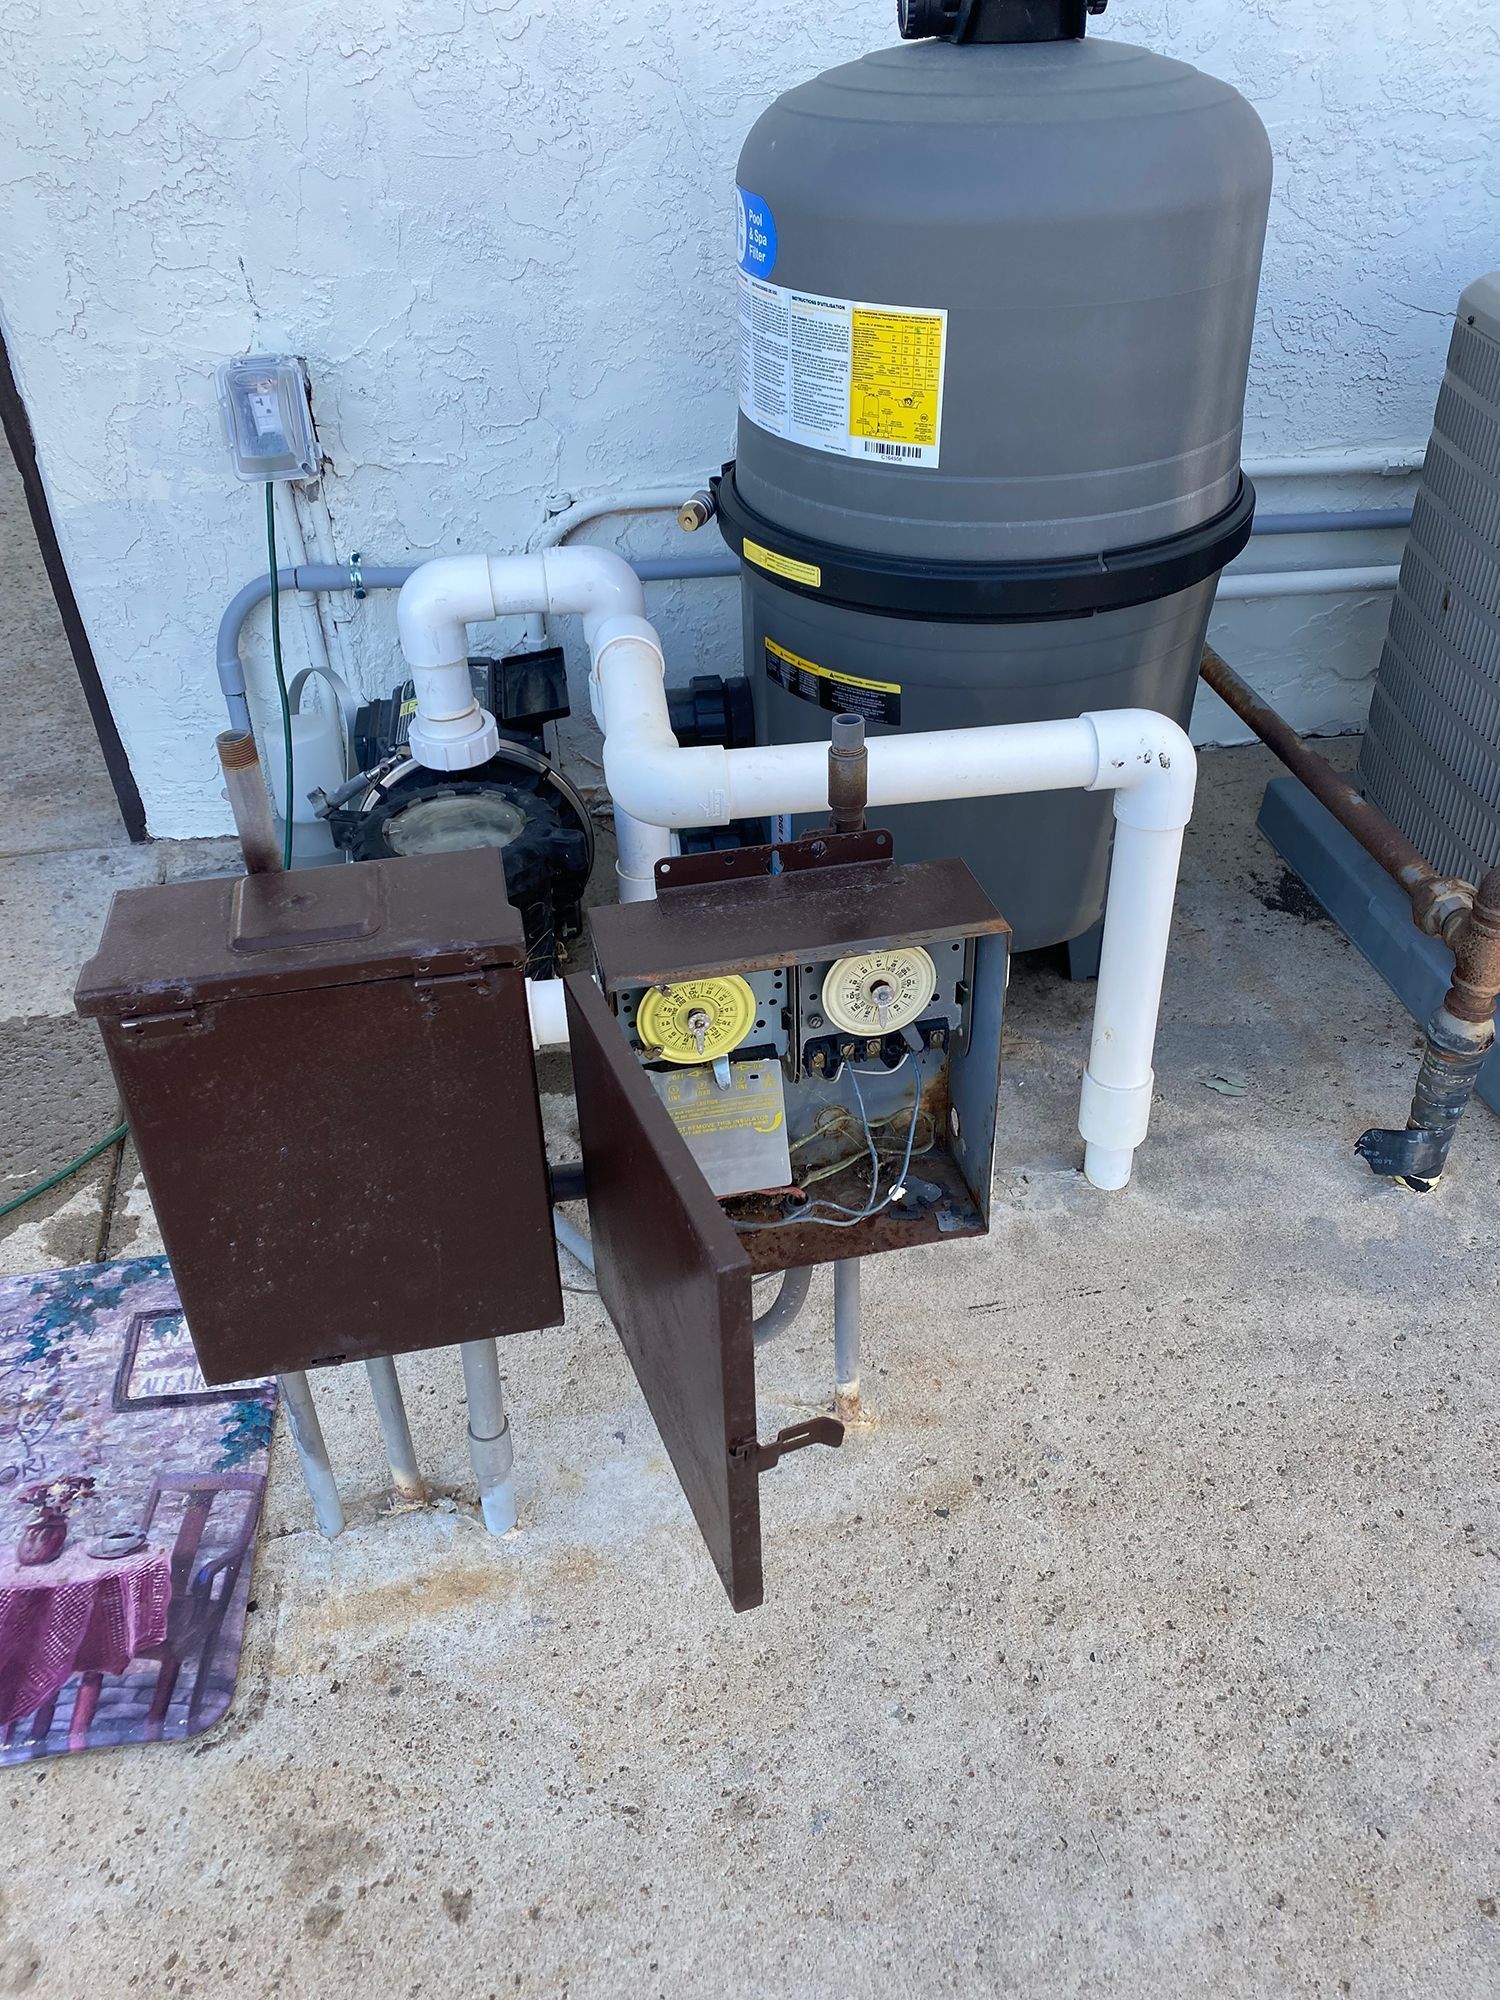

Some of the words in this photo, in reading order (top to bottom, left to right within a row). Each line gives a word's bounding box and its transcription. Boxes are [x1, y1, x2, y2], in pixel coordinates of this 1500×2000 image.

[748, 208, 763, 226] Pool
[749, 226, 754, 241] &
[754, 229, 767, 246] Spa
[749, 244, 766, 262] Filter
